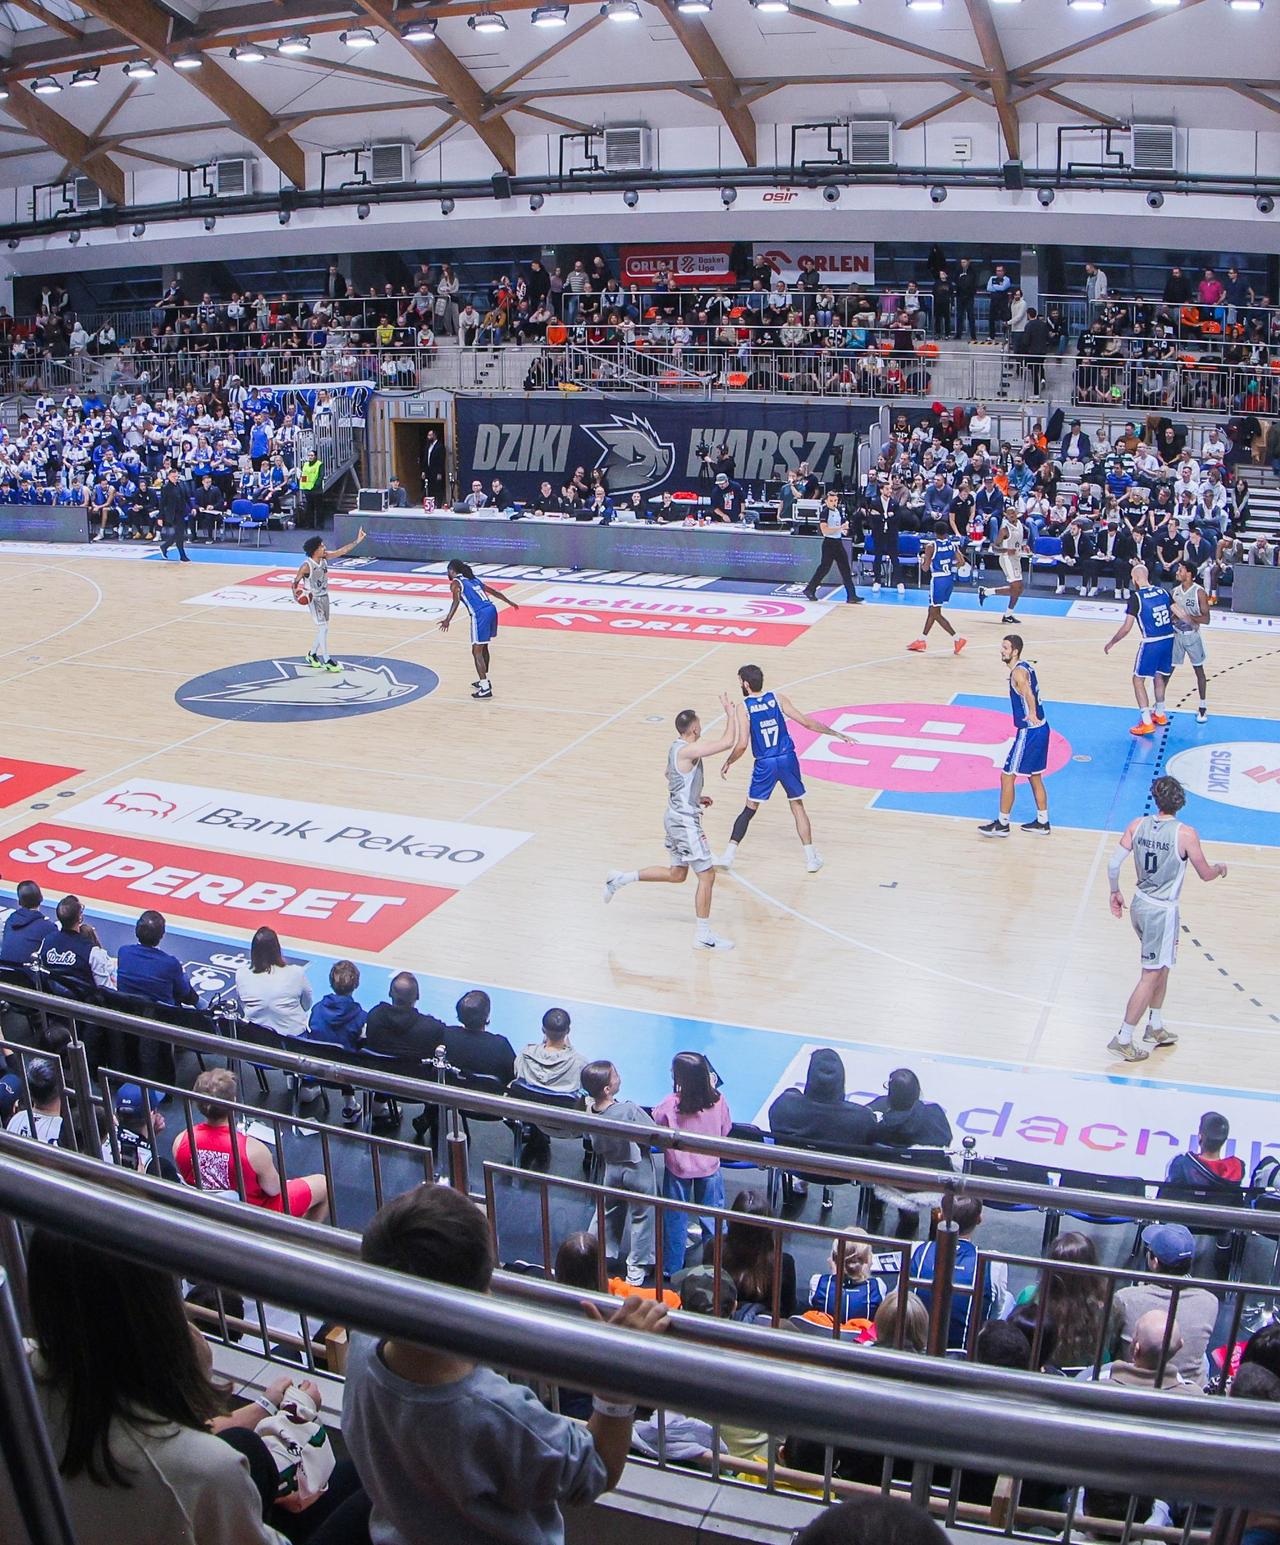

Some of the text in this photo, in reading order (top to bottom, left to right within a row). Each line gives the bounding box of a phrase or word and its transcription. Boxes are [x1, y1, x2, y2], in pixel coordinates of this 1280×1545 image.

[797, 255, 869, 273] ORLEN
[472, 424, 573, 474] DZIKI
[351, 600, 443, 615] Pekao
[546, 594, 727, 615] netuno
[609, 619, 756, 637] ORLEN
[1152, 610, 1170, 627] 32
[761, 726, 779, 748] 17
[1207, 750, 1232, 794] SUZUKI
[197, 806, 487, 864] Bank Pekao
[1144, 851, 1158, 874] 0
[7, 838, 407, 924] SUPERBET
